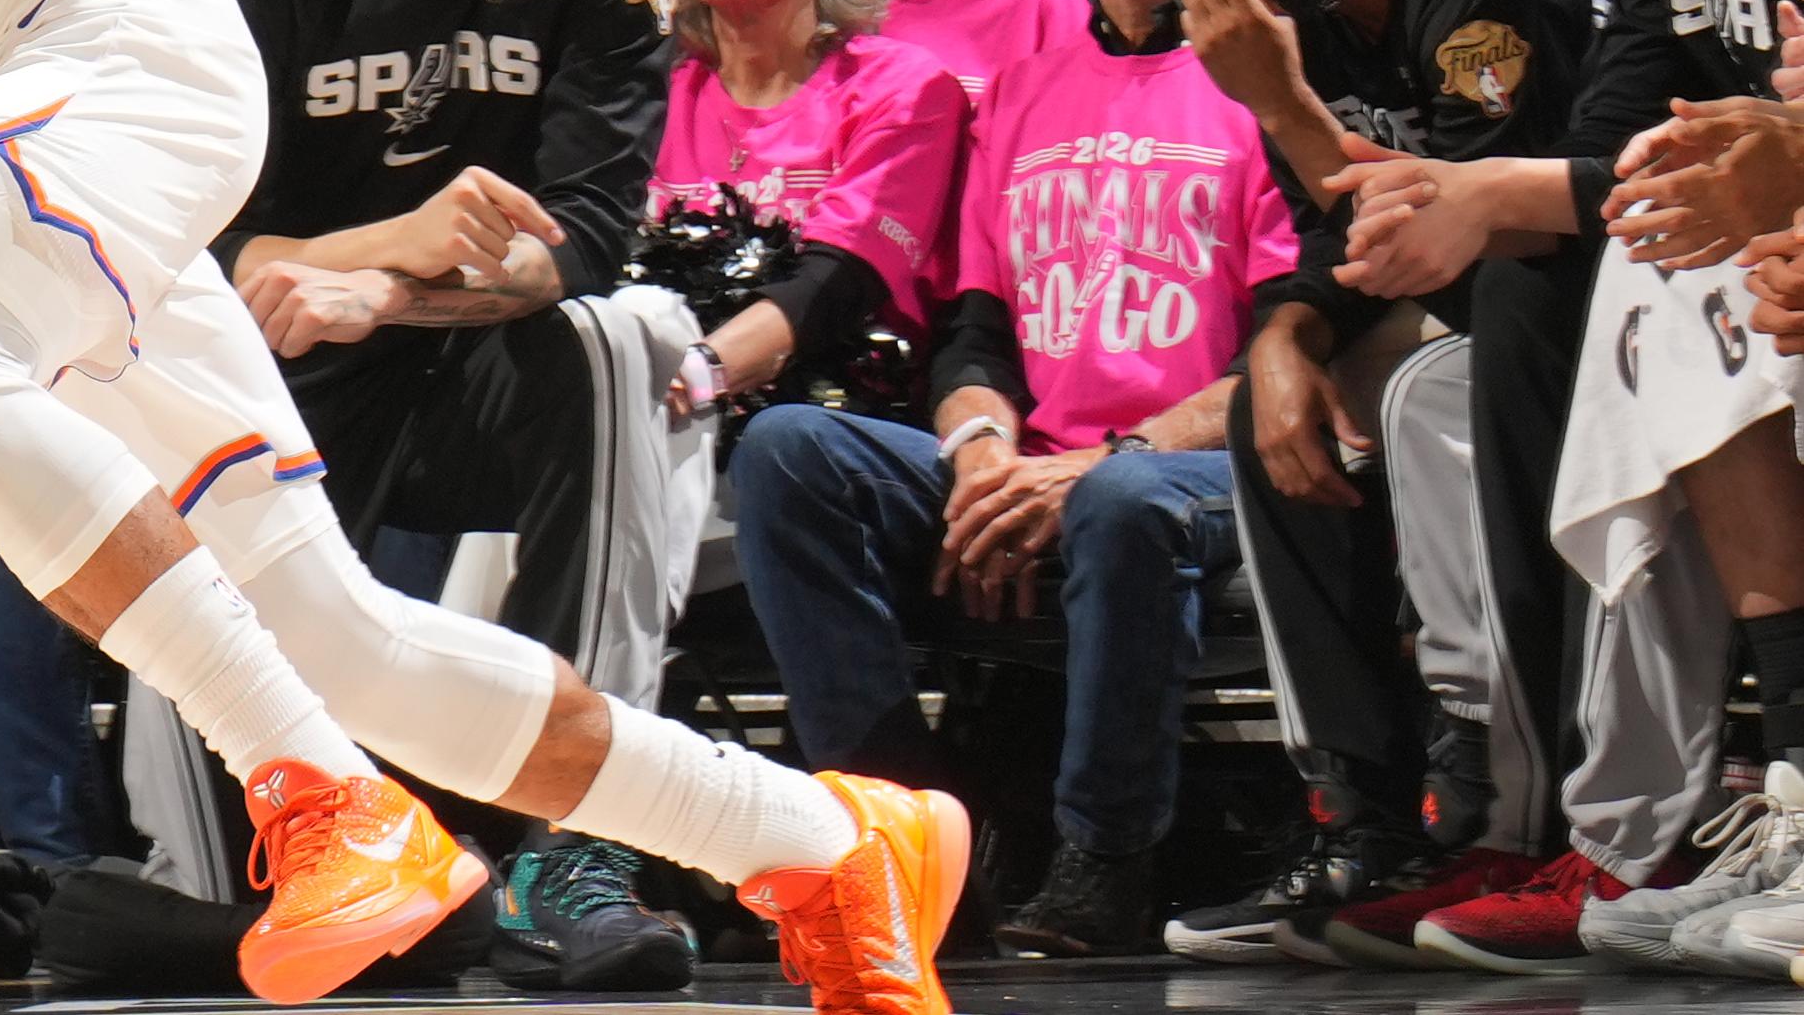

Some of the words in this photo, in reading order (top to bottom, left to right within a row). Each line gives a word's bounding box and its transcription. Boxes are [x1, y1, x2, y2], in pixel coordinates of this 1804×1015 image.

[1442, 31, 1526, 81] Finals
[1070, 132, 1157, 166] 226
[1000, 168, 1230, 287] FINALS
